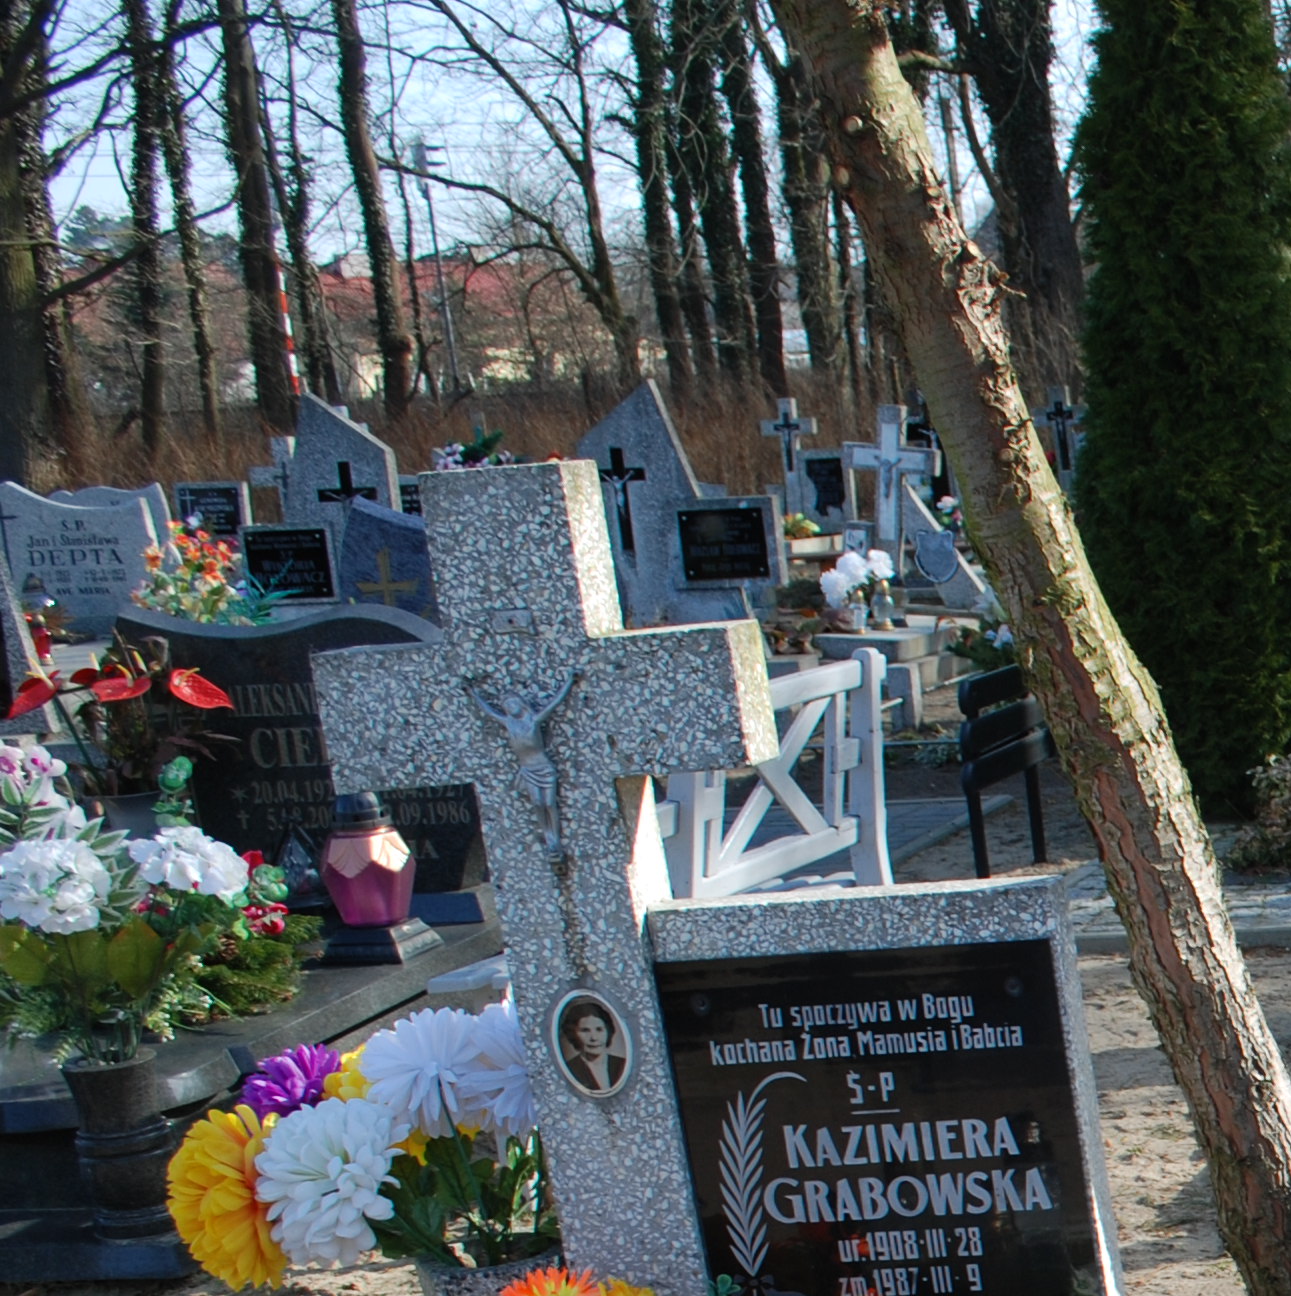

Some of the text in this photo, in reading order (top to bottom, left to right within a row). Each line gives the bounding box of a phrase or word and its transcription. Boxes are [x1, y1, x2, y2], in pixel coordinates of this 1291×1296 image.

[26, 547, 126, 568] DEPTA
[758, 992, 975, 1030] Tu spoczywa w Bogu
[709, 1038, 797, 1066] kochana
[857, 1025, 947, 1057] Mamusia
[951, 1025, 959, 1050] i
[960, 1021, 1023, 1050] Babcia
[782, 1115, 1021, 1170] KAZIMIERA
[763, 1166, 1054, 1224] GRABOWSKA
